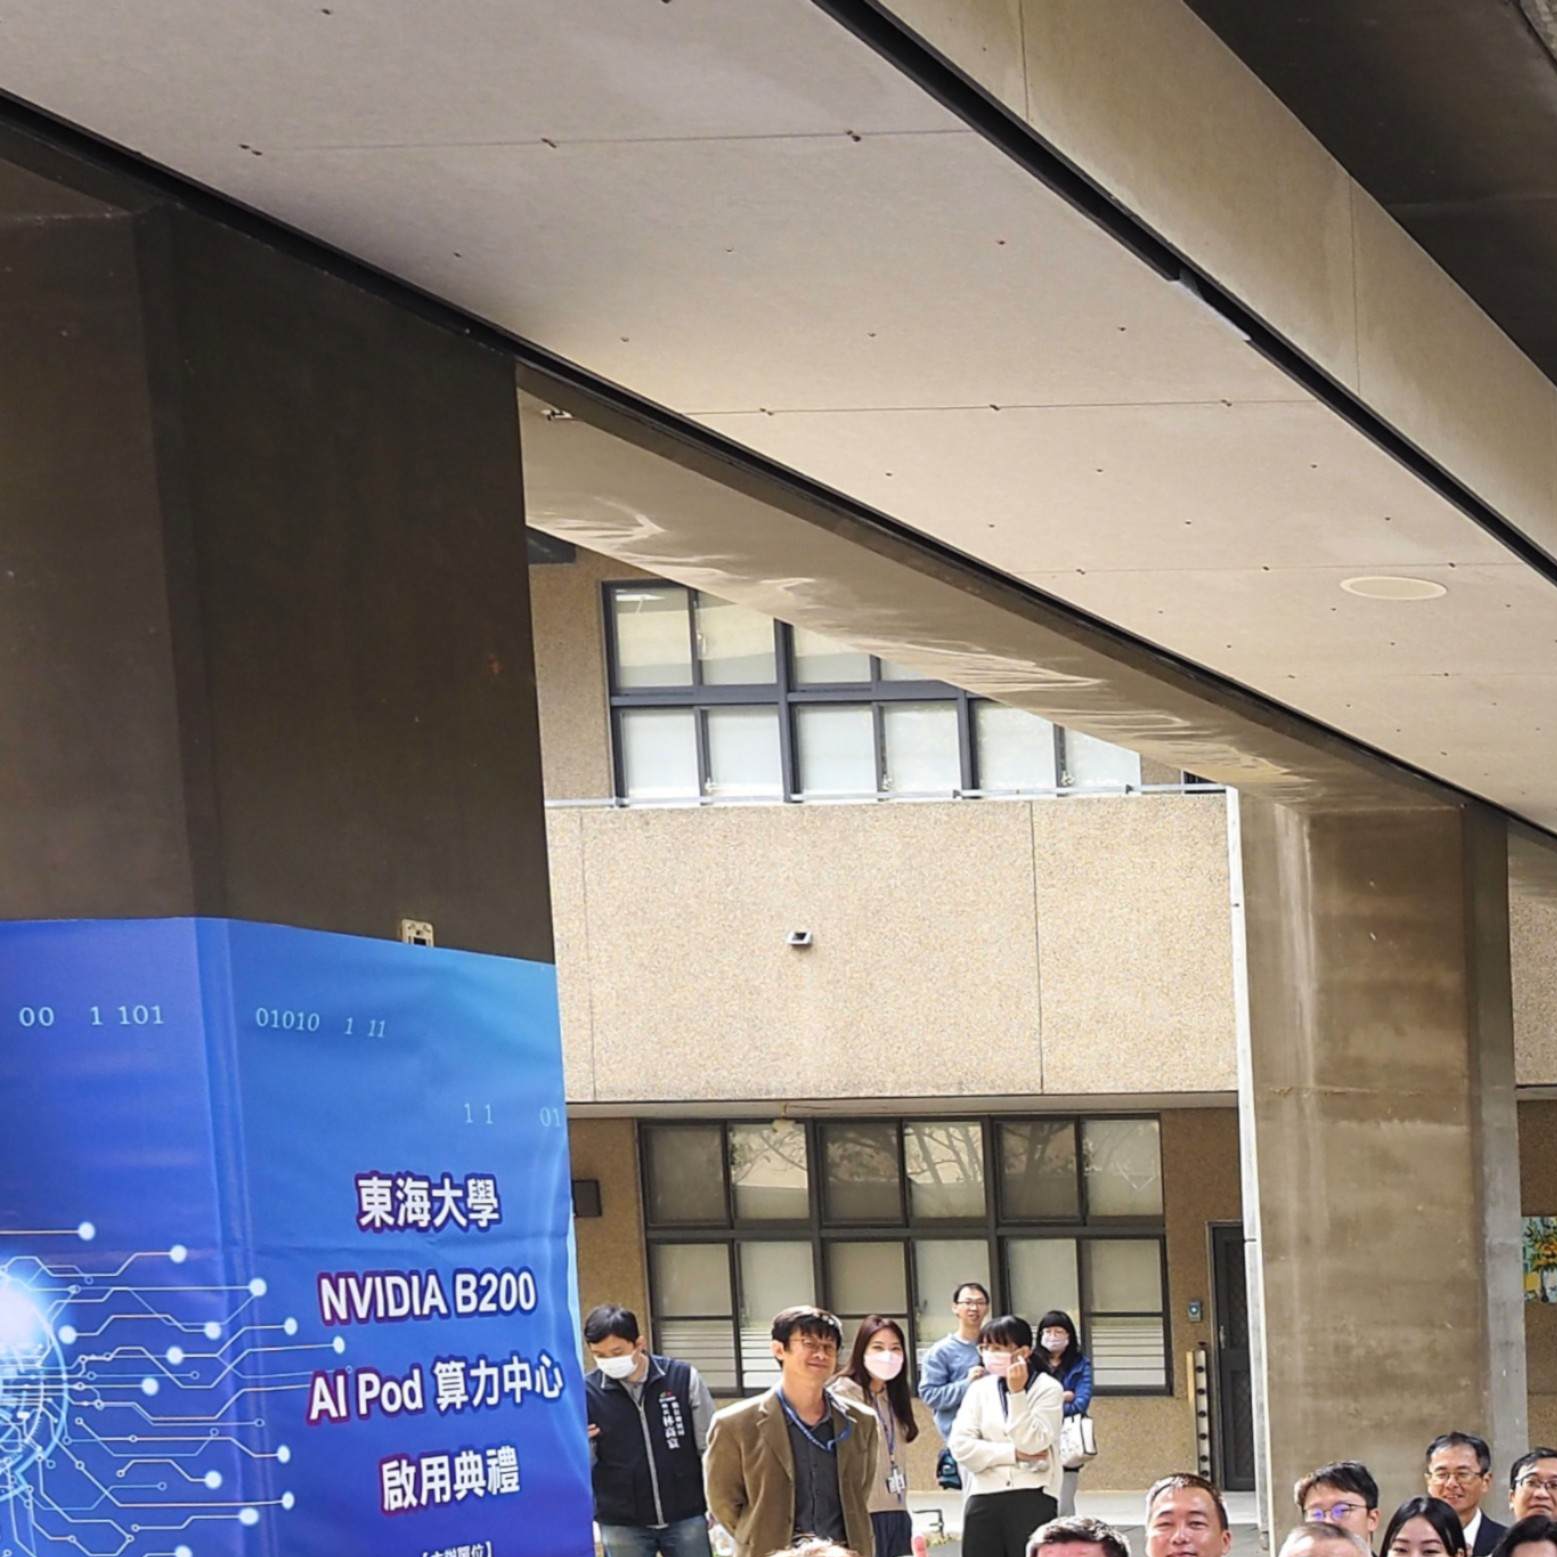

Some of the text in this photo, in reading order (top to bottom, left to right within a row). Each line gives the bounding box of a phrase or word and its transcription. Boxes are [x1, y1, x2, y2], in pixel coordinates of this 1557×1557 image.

[19, 1006, 54, 1027] 00
[118, 1005, 164, 1025] 101
[255, 1008, 320, 1032] 01010
[357, 1177, 500, 1229] 東海大學
[318, 1272, 536, 1322] NVIDIA B200
[309, 1353, 563, 1420] AI Pod 算力中心
[381, 1445, 521, 1512] 啟用典禮
